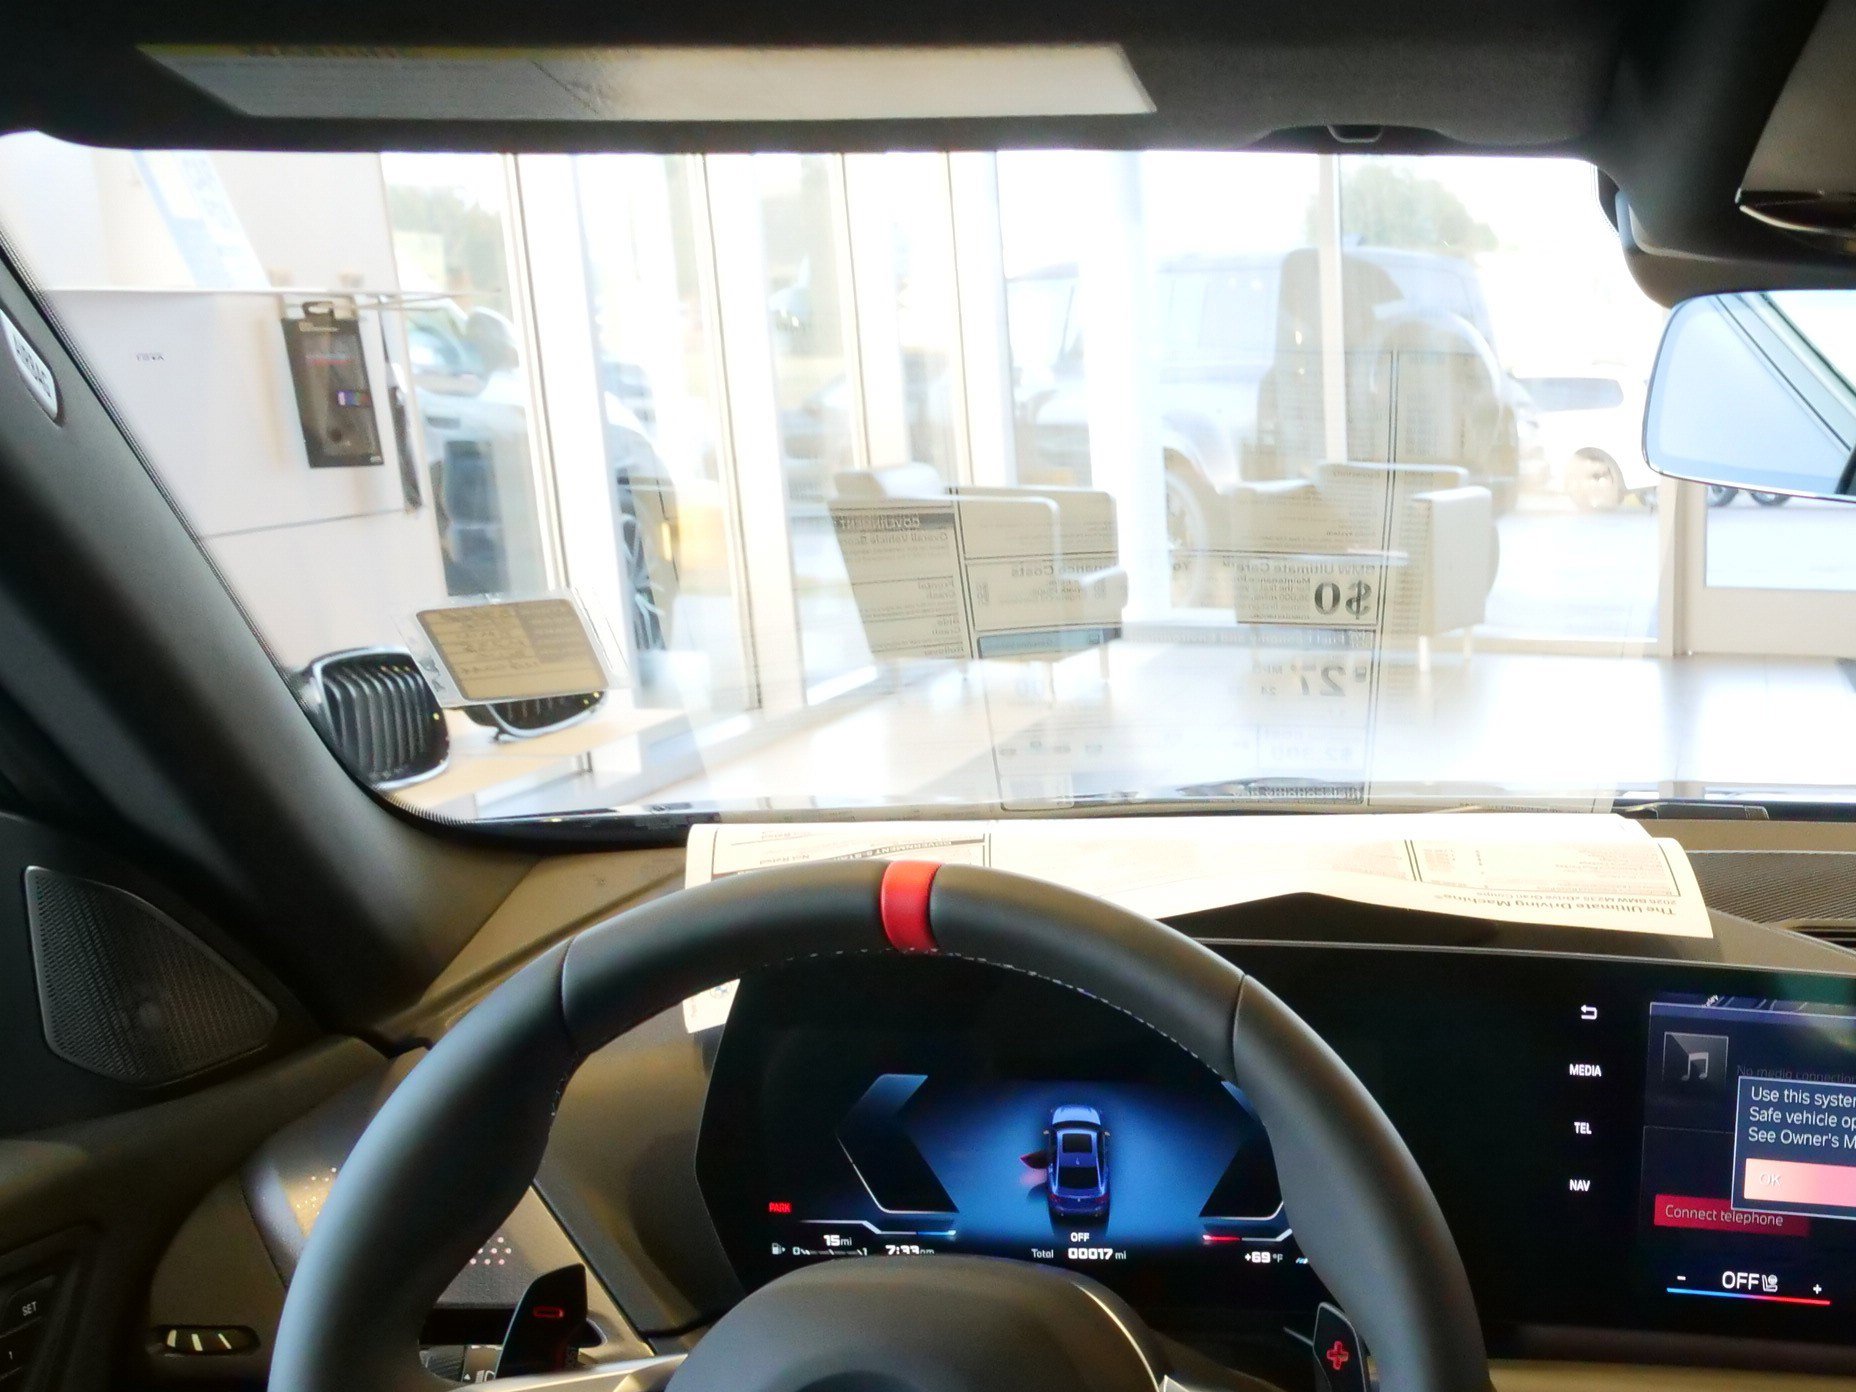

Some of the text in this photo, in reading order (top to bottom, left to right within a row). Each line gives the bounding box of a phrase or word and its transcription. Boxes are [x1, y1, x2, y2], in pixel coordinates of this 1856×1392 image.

[1515, 899, 1572, 910] Driving
[1575, 902, 1643, 913] Ultimate
[1647, 905, 1676, 916] The
[1568, 1063, 1602, 1077] MEDIA
[1750, 1085, 1780, 1103] Use
[1783, 1088, 1811, 1105] this
[1749, 1105, 1782, 1124] Safe
[1785, 1109, 1838, 1128] vehicle
[1573, 1121, 1593, 1135] TEL
[1747, 1126, 1776, 1144] See
[1780, 1128, 1840, 1149] Owner's
[1568, 1178, 1591, 1192] NAV
[1758, 1172, 1783, 1187] OK
[767, 1201, 793, 1214] PARK
[1664, 1203, 1784, 1228] Connect telephone
[1070, 1231, 1090, 1243] OFF
[1031, 1247, 1128, 1261] Total 00017 mi
[1721, 1270, 1760, 1291] OFF
[21, 1300, 38, 1317] SET
